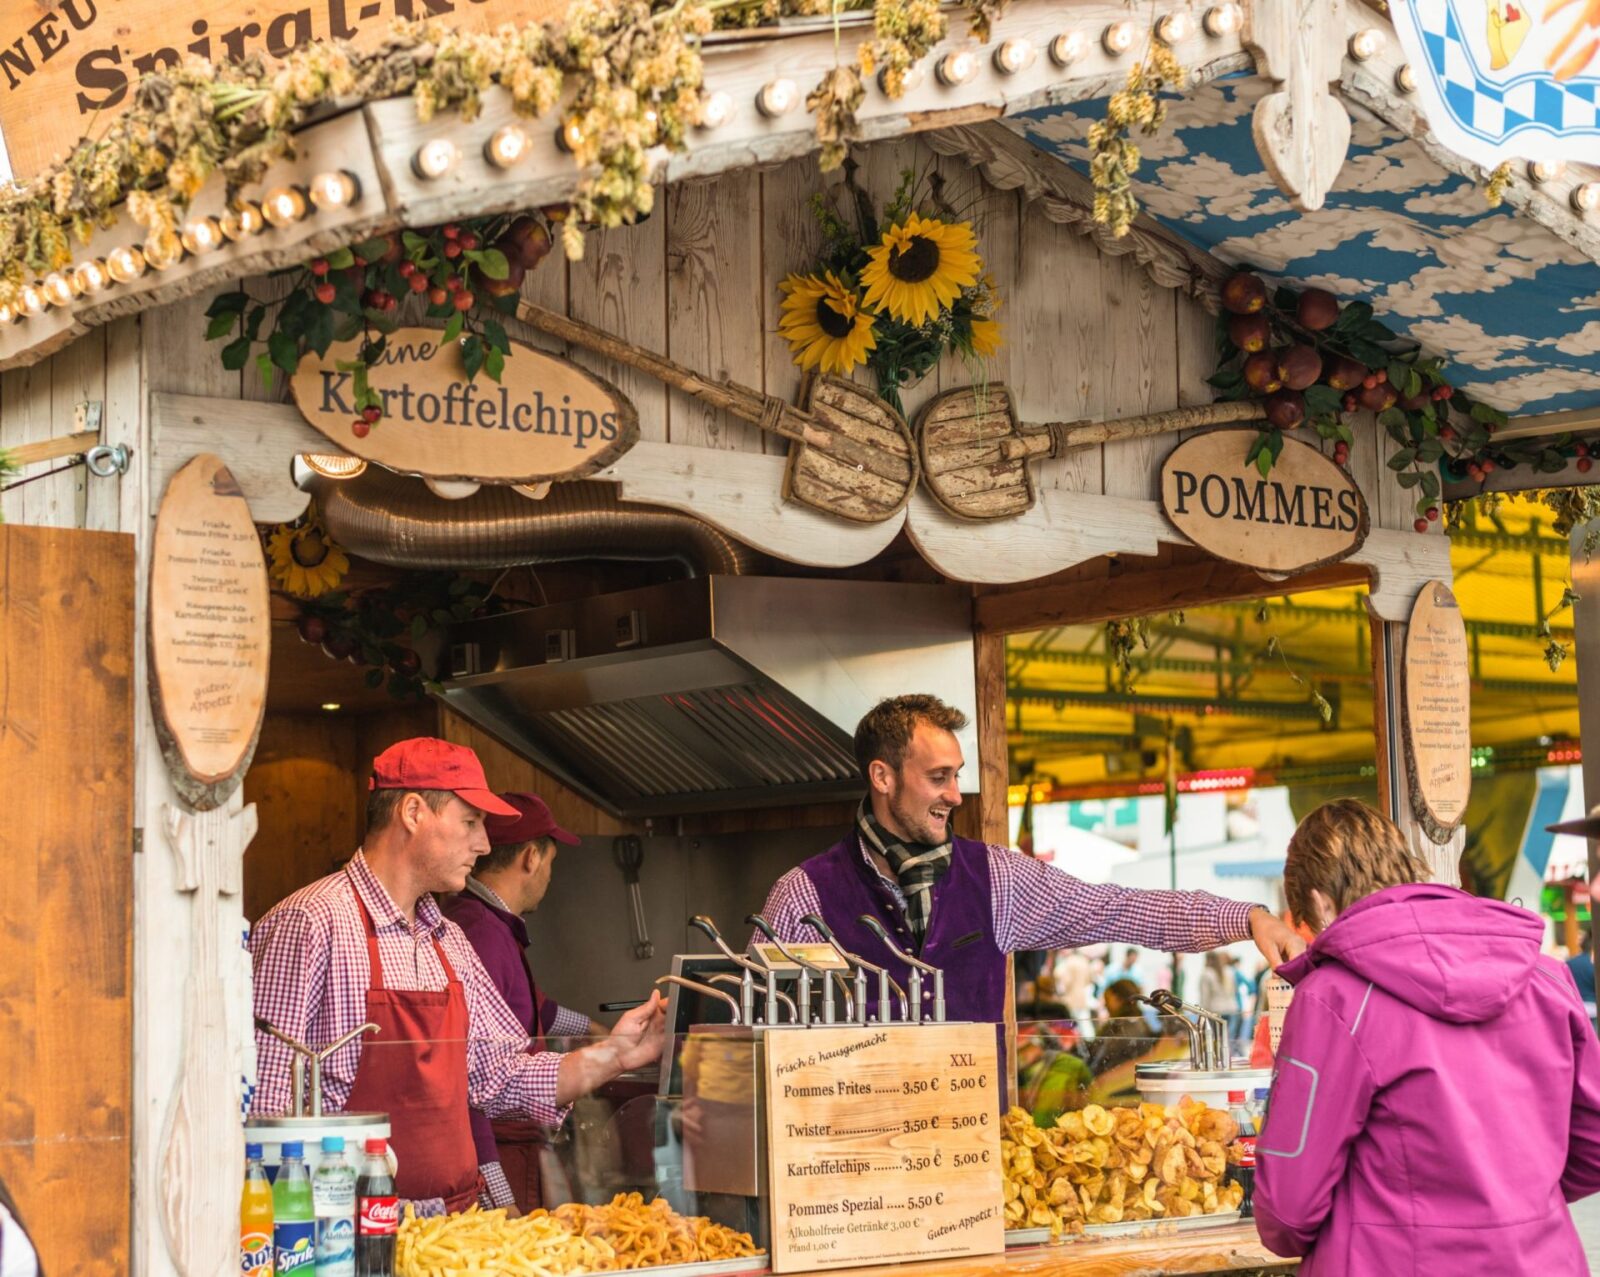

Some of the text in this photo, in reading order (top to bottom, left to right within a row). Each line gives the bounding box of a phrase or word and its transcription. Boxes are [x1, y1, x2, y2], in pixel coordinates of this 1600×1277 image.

[319, 370, 619, 450] Krtoffelchips
[1172, 470, 1359, 532] POMMES
[776, 1032, 888, 1078] frisch & hausgemacht
[950, 1053, 976, 1067] XXL
[784, 1074, 987, 1098] Pommes Frites 3,50 € 5,00 €
[786, 1112, 988, 1137] Twister 3,50 € 5,00 €
[787, 1150, 990, 1177] Kartoffelchips 3,50 € 5,00 €
[788, 1191, 944, 1217] Pommes Spezial 5,50 €
[788, 1217, 920, 1239] Alkoholfreie Getränke 3,00 €
[927, 1223, 957, 1241] Guten
[958, 1207, 993, 1230] Appetit
[788, 1242, 811, 1253] Pfand
[813, 1243, 830, 1252] 1,00
